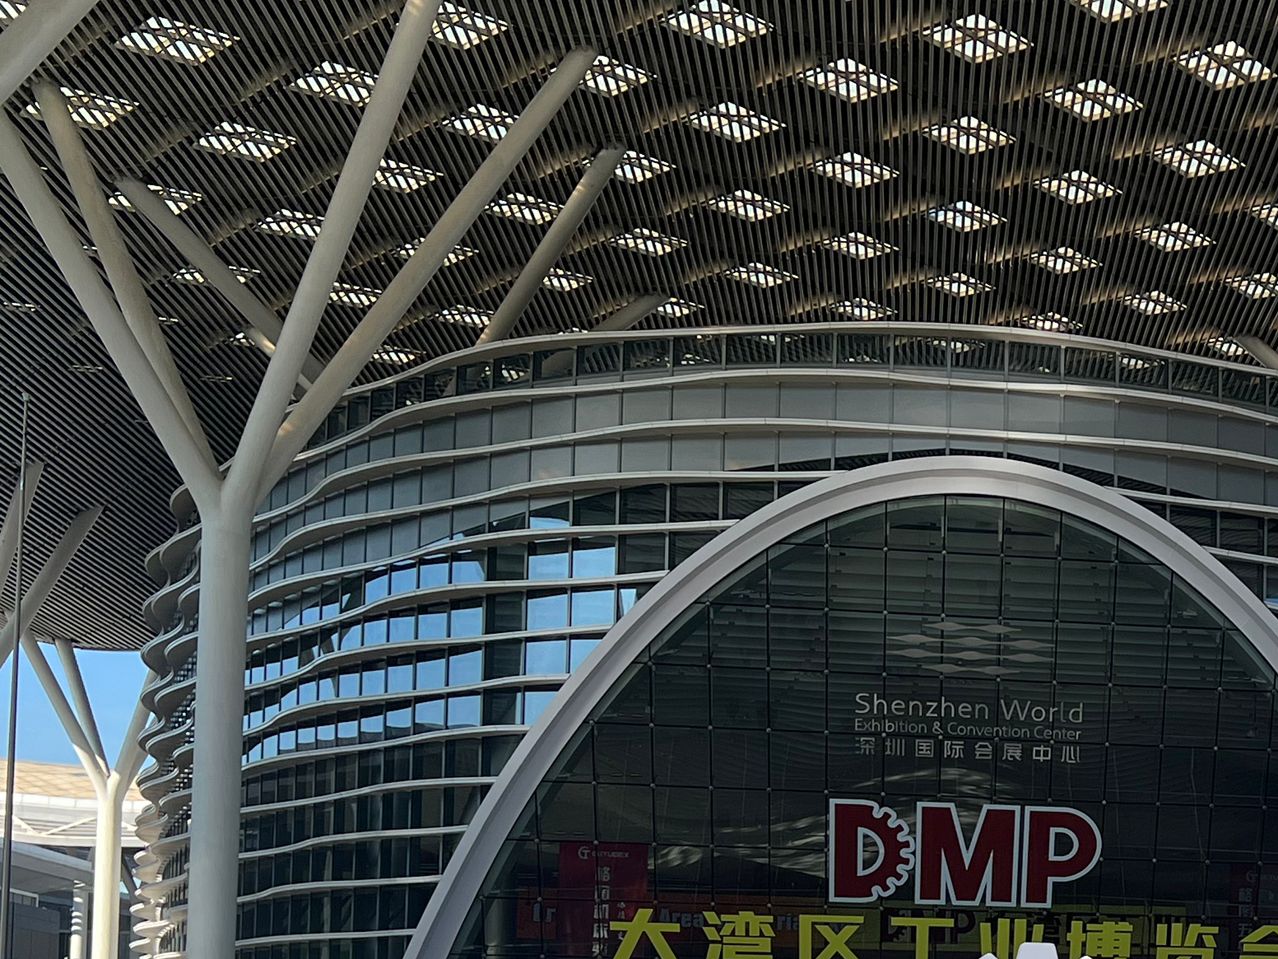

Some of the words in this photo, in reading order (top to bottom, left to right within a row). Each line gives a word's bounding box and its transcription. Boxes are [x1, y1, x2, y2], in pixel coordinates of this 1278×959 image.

[855, 693, 988, 719] Shenzhen
[1001, 699, 1083, 723] World
[855, 718, 928, 734] Exhibition
[932, 720, 943, 735] &
[947, 722, 1032, 738] Convention
[1034, 725, 1082, 740] Center
[855, 737, 1081, 763] 深圳国际会展中心
[829, 798, 1101, 908] DMP
